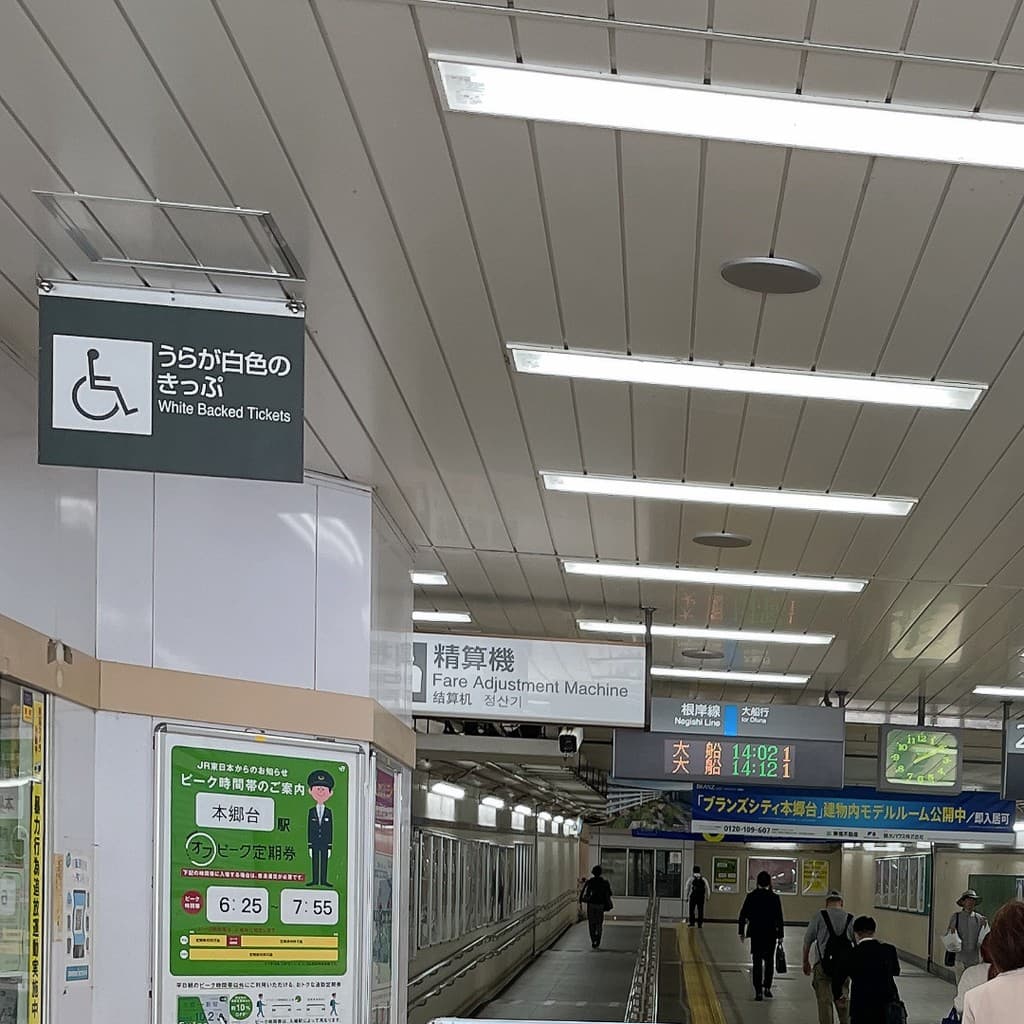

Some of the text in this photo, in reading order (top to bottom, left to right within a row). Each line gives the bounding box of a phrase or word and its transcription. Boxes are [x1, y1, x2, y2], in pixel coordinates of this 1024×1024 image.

[157, 344, 292, 378] うらが白色の
[157, 372, 225, 399] きっぷ
[158, 400, 292, 423] White Backed Tickets
[433, 643, 515, 672] 精算機
[433, 673, 629, 698] Fare Adjustment Machine
[432, 691, 473, 706] 结算机
[484, 693, 522, 709] 정산기
[681, 703, 770, 717] 根岸線 大船行
[704, 719, 721, 727] Line
[732, 743, 778, 761] 14:02
[783, 746, 791, 762] 1
[196, 760, 288, 778] JR東日本からのお知らせ
[732, 760, 778, 777] 14:12
[782, 762, 790, 778] 1
[181, 773, 305, 796] ピーク時間帯のご案内
[212, 804, 260, 824] 本郷台
[277, 818, 290, 832] 駅
[723, 823, 771, 834] 0120-109-607
[219, 897, 333, 916] 6:25 7:55
